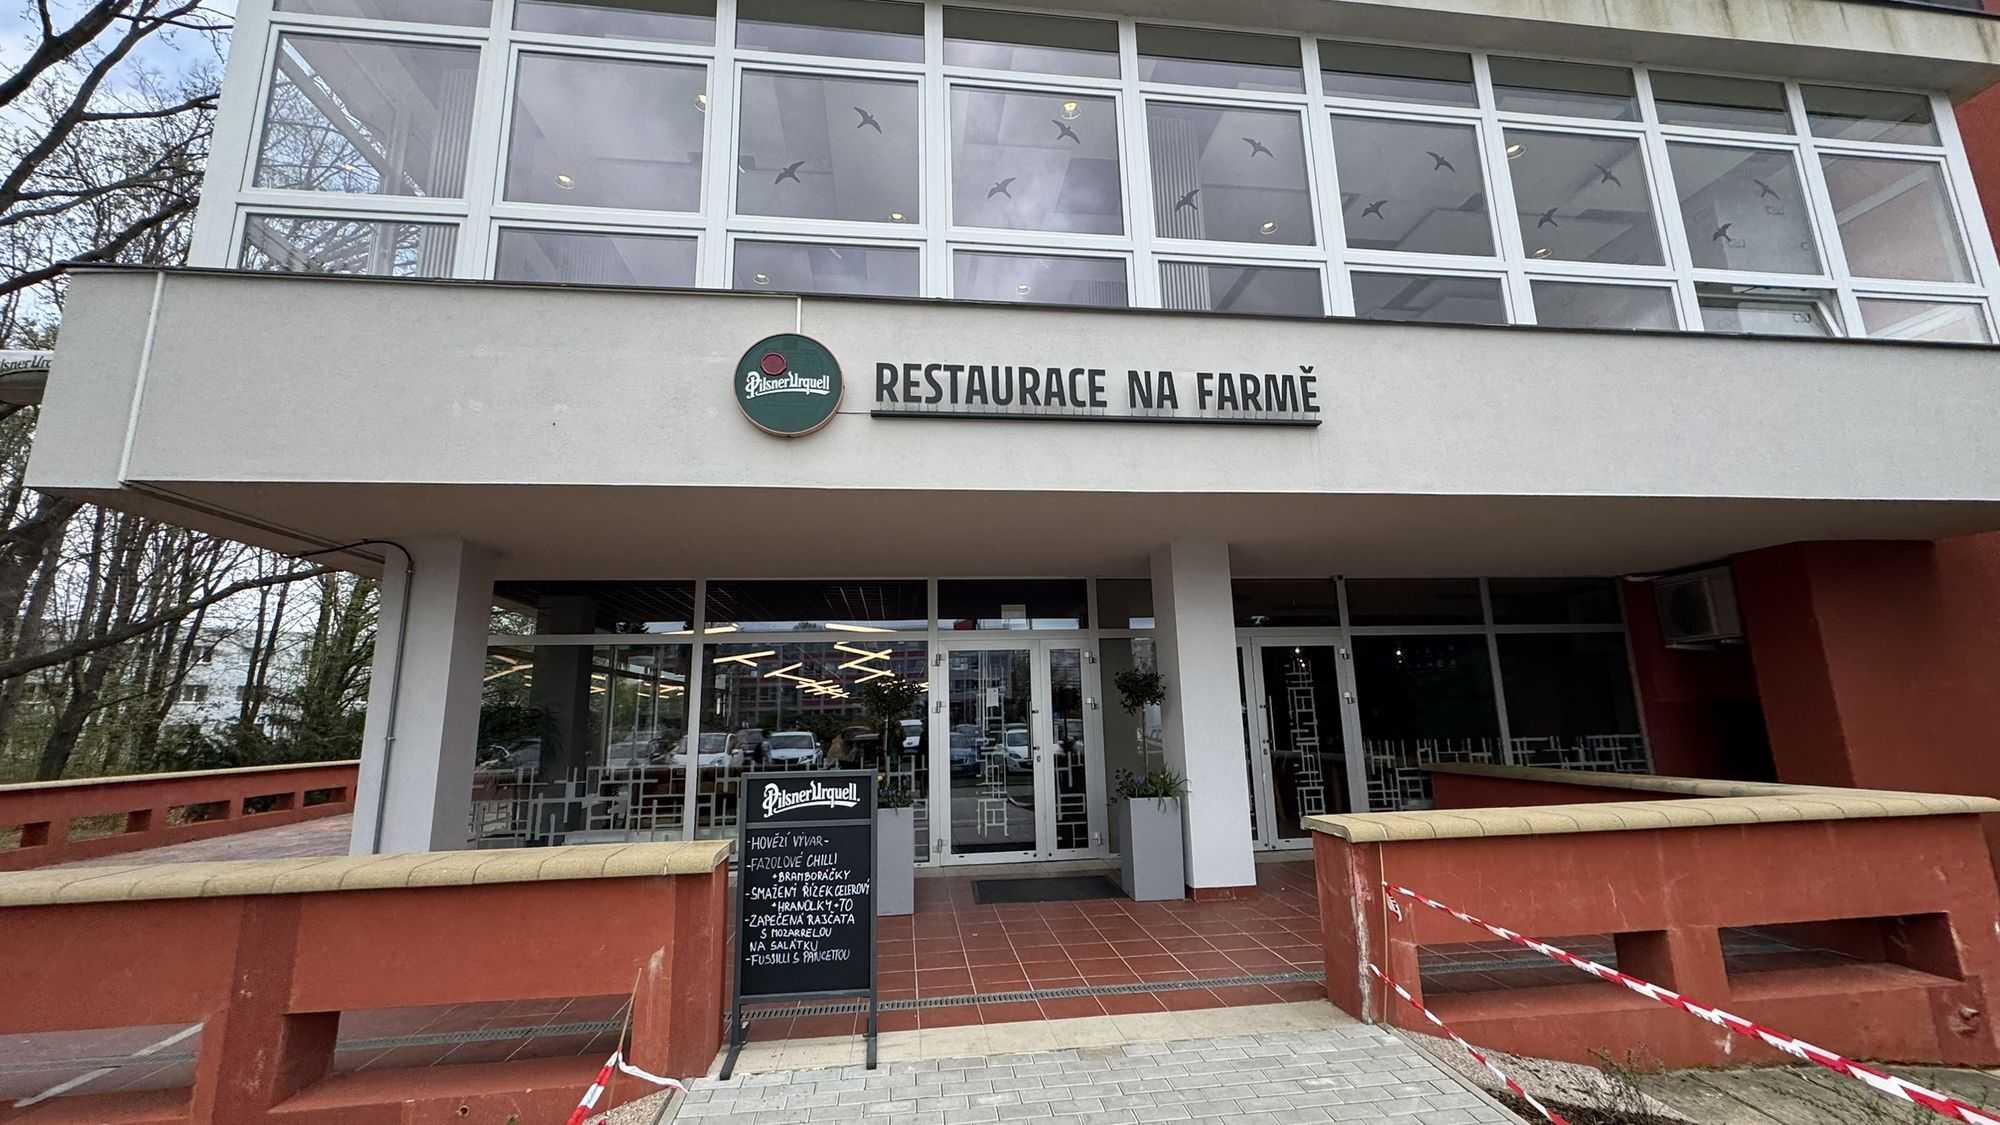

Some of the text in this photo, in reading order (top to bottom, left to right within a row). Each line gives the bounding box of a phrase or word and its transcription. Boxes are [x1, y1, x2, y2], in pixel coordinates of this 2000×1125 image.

[745, 371, 829, 399] Pilsner Urquell
[875, 362, 1321, 413] RESTAURACE NA FARMĚ
[762, 782, 812, 818] Pilsner
[807, 852, 837, 867] CHILLI
[760, 928, 767, 939] S
[749, 938, 819, 952] NA SALÁTKU
[792, 952, 800, 963] S
